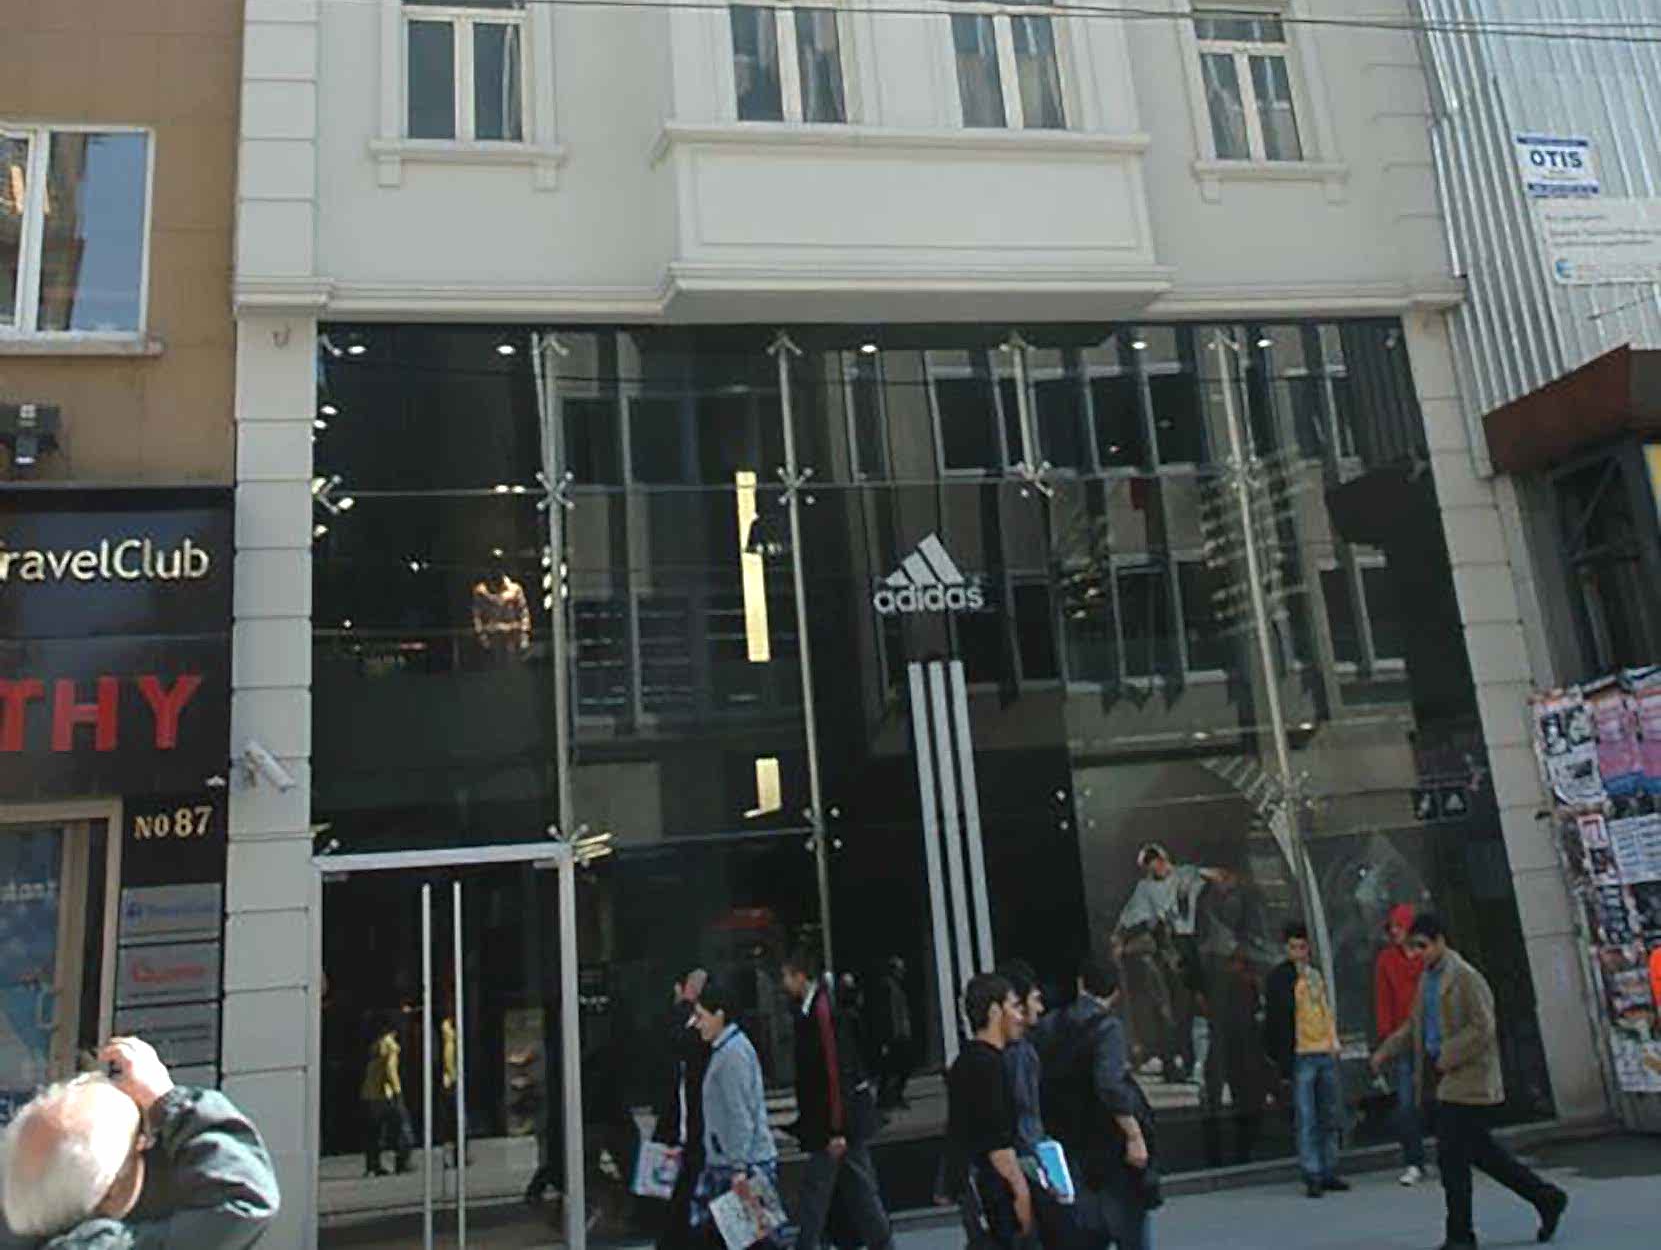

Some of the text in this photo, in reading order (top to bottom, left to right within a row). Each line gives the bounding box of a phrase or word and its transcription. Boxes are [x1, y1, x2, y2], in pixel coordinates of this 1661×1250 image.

[1530, 150, 1582, 168] OTIS
[0, 538, 209, 580] ravelClub
[873, 583, 984, 614] adidas
[0, 675, 203, 752] THY
